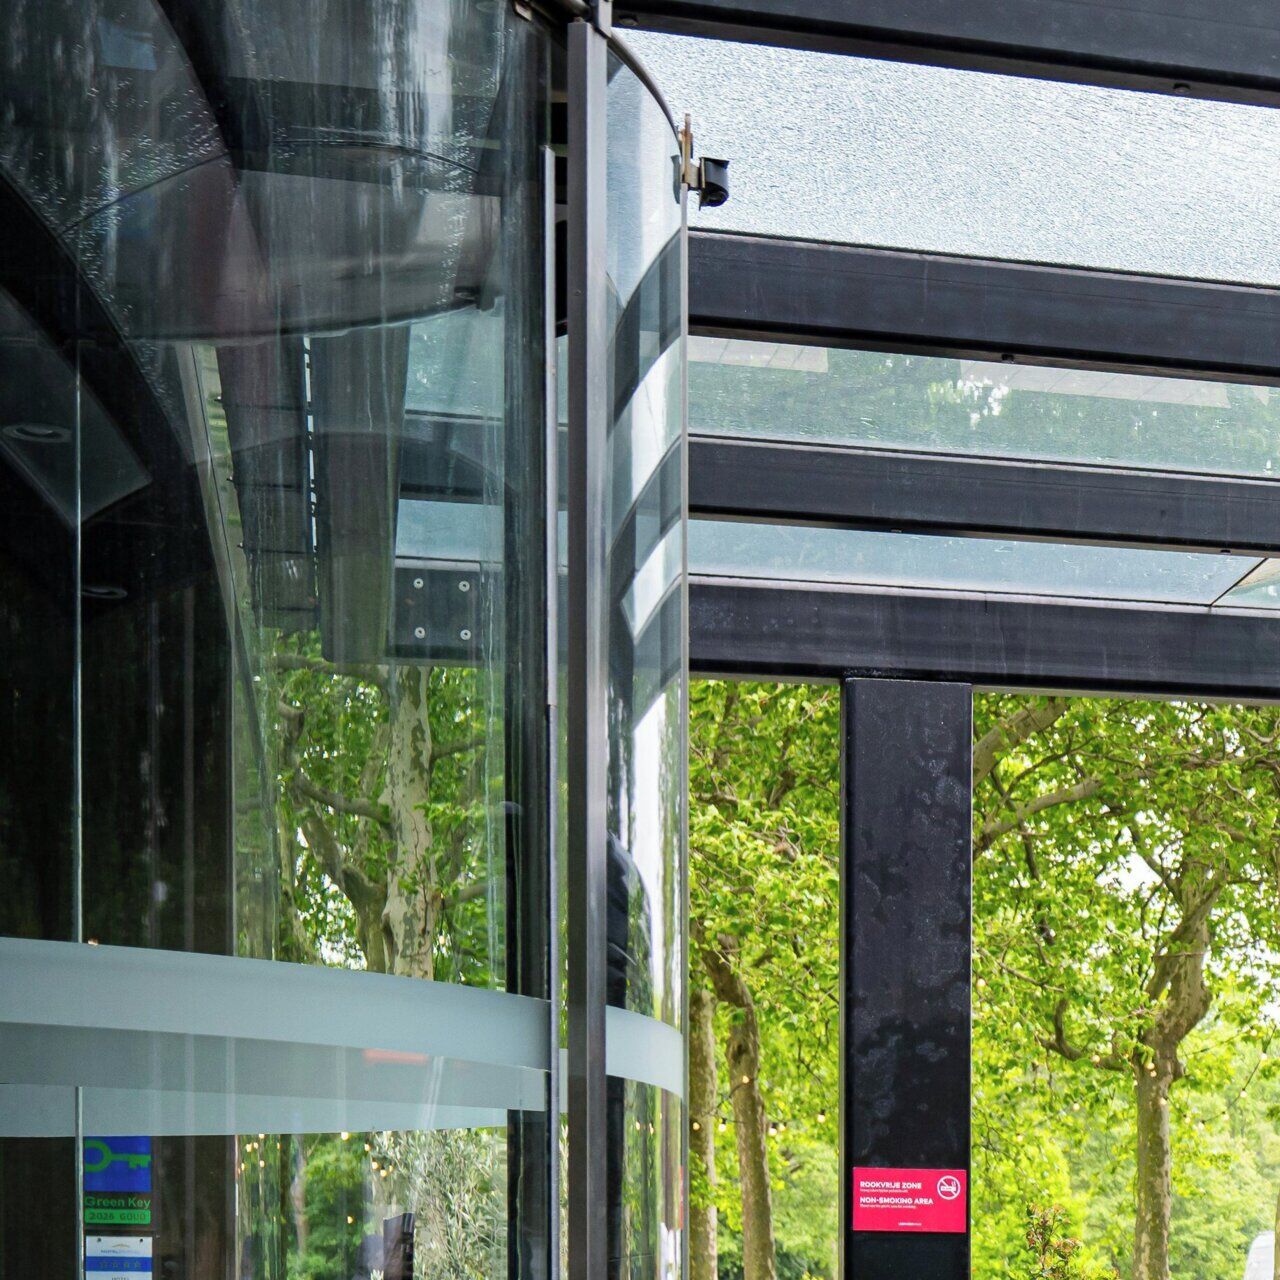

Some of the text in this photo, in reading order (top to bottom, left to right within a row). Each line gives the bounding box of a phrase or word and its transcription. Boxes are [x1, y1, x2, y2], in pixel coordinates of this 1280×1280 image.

[85, 1196, 151, 1209] Green Key
[860, 1196, 913, 1204] NON-SMOKING
